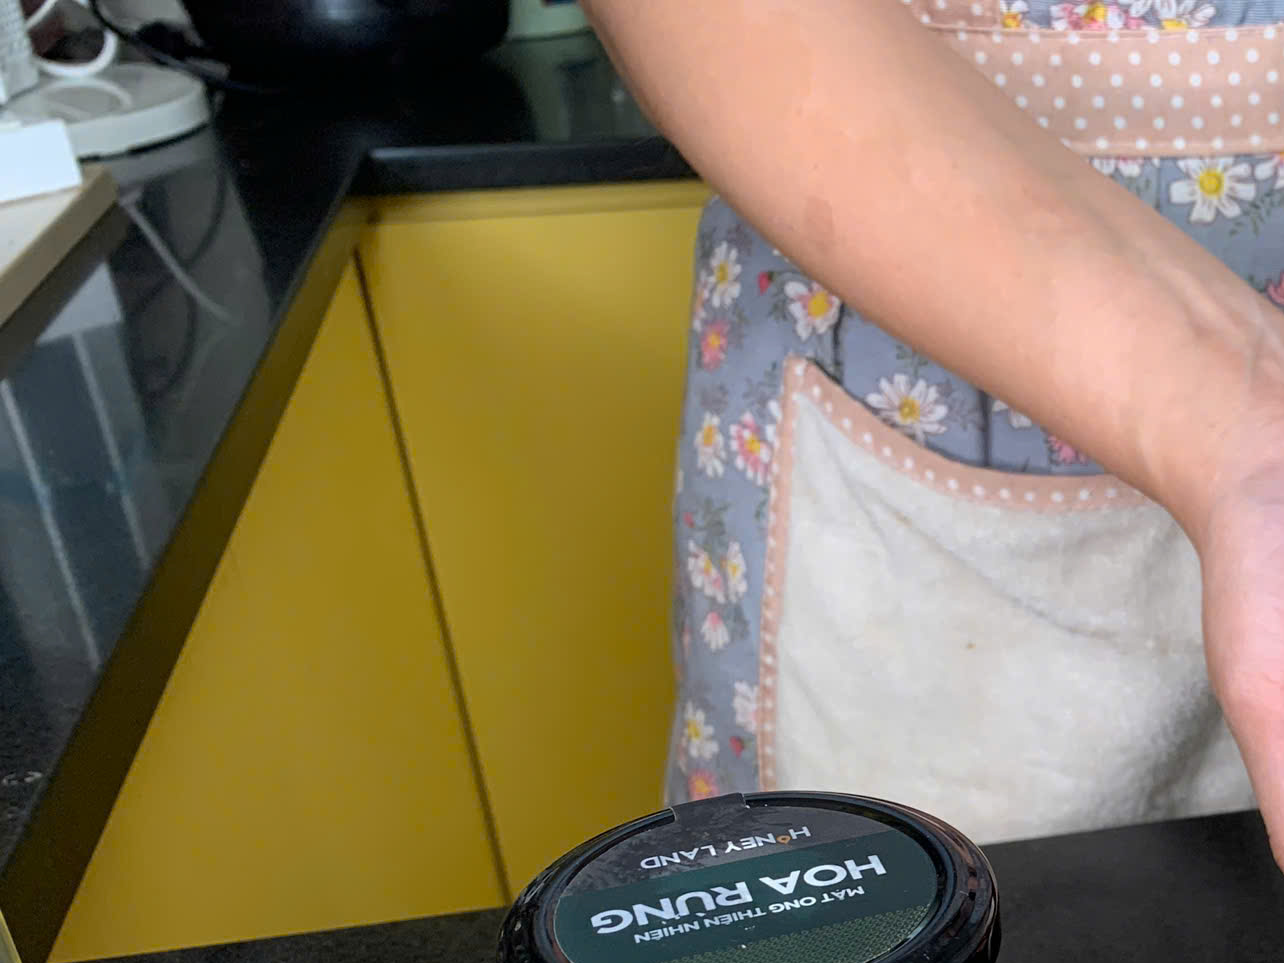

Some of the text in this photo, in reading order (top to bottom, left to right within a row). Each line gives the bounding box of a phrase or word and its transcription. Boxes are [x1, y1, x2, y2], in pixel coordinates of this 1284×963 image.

[640, 826, 812, 869] HONEY LAND
[759, 854, 888, 895] HOA
[768, 896, 818, 914] ONG
[703, 907, 767, 928] THIÊN
[634, 921, 700, 944] NHIÊN
